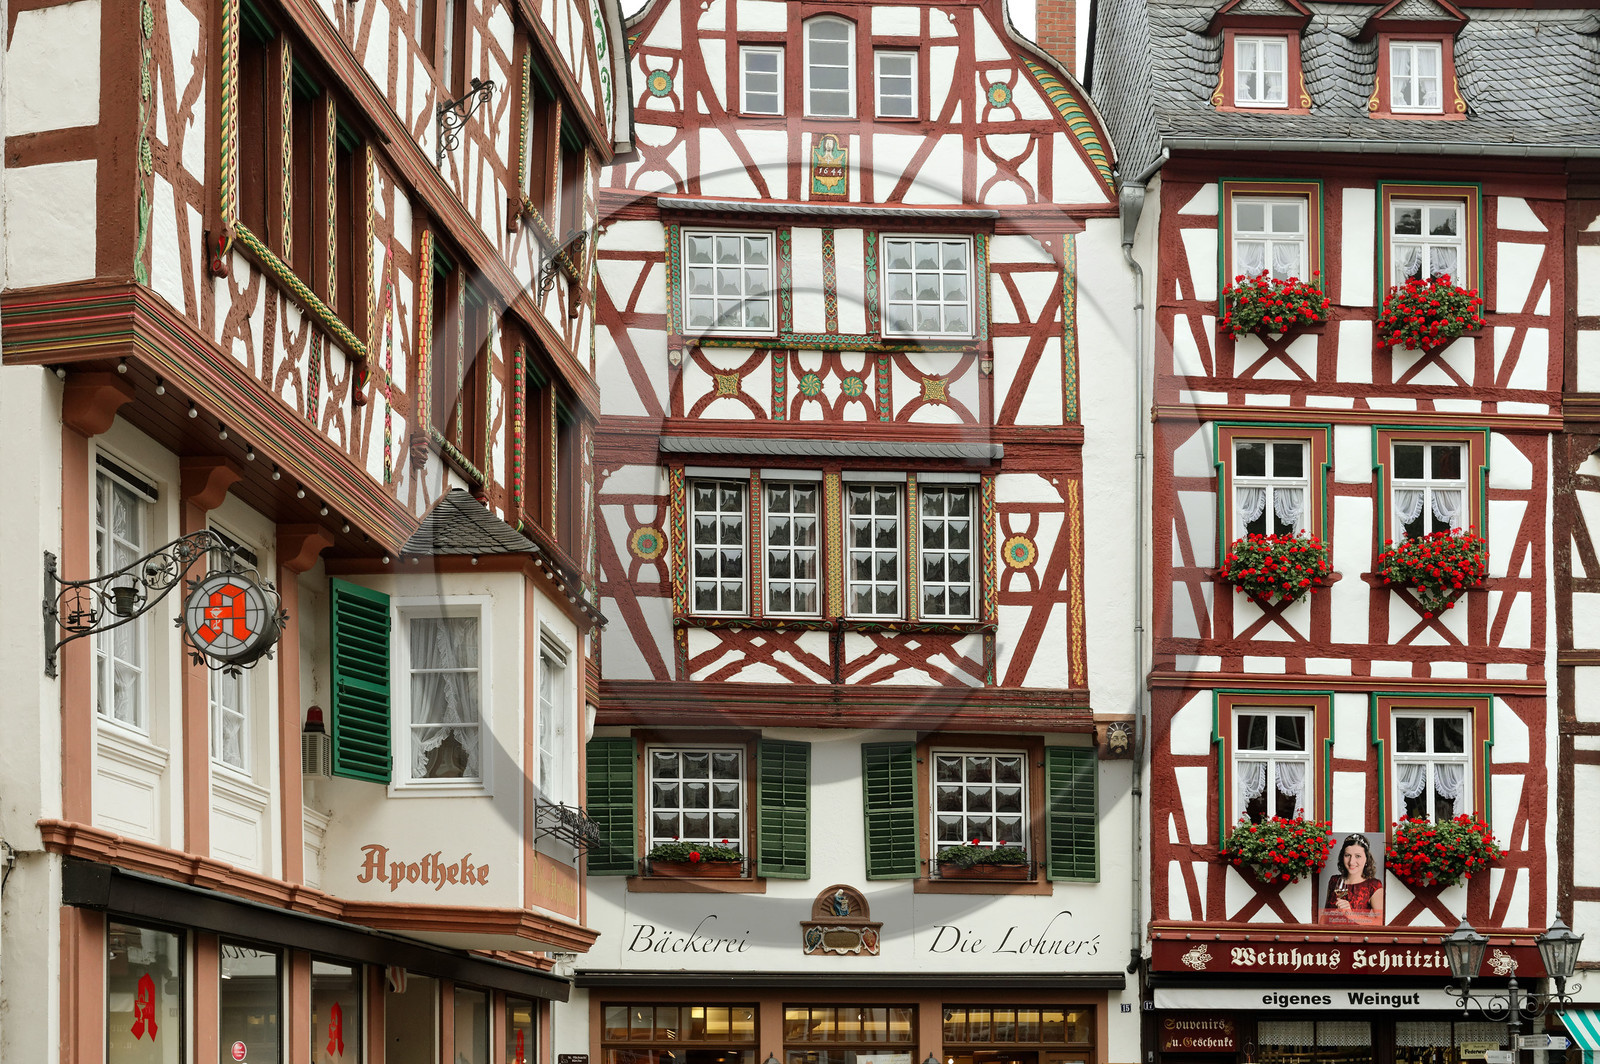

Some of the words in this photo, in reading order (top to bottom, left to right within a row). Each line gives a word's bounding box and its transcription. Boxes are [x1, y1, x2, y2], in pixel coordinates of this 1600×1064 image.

[818, 167, 843, 176] 1644
[357, 844, 490, 892] Apotheke
[628, 914, 752, 953] Bäckerei
[928, 925, 987, 953] Die
[1230, 947, 1341, 971] Weinhaus
[1145, 1002, 1153, 1010] 17
[1262, 992, 1332, 1007] eigenes
[1348, 992, 1420, 1007] Weingut
[1122, 1004, 1130, 1012] 15
[1164, 1018, 1225, 1030] Souvenirs
[1182, 1037, 1233, 1048] Geschenke
